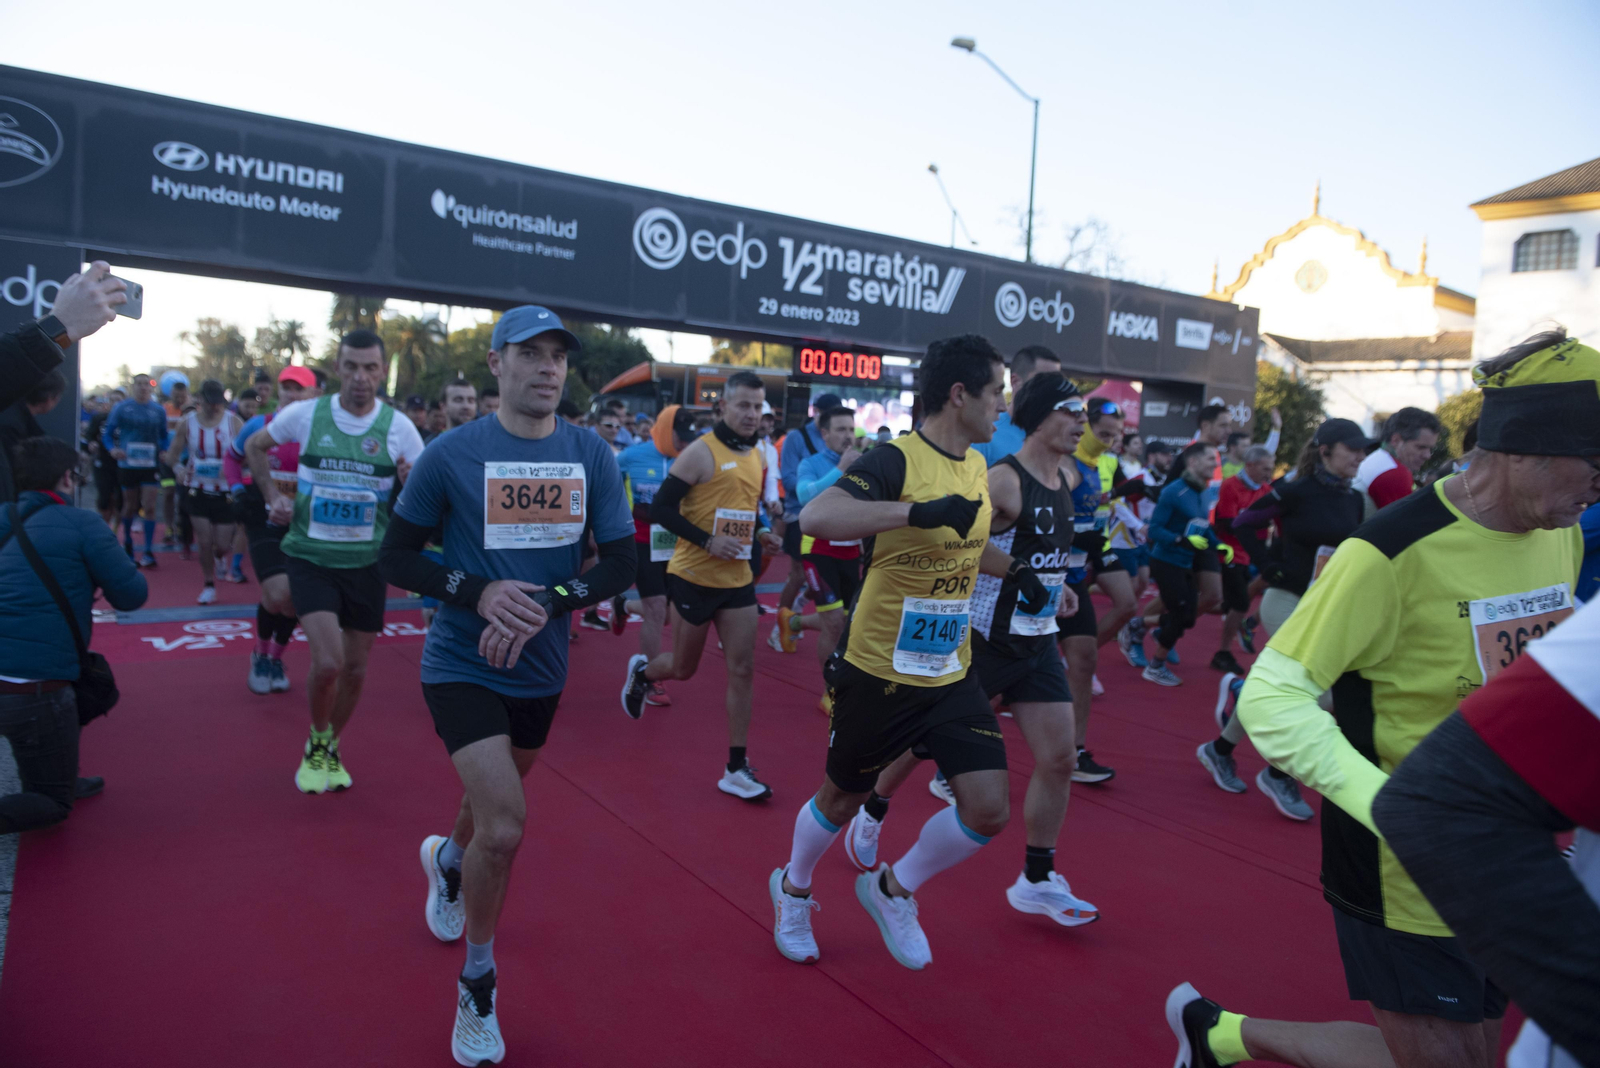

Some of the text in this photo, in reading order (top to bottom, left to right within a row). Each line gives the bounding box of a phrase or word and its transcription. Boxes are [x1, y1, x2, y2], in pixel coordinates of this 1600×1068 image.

[215, 151, 344, 194] HYUNDAI
[152, 175, 342, 222] Hyundauto Motor
[472, 232, 576, 261] Healthcare Partner
[690, 221, 768, 280] edp
[815, 242, 939, 288] maratón
[0, 264, 63, 319] dp
[847, 277, 942, 315] sevilla
[758, 297, 861, 327] 29 enero 2023
[1028, 290, 1075, 334] edp
[1106, 310, 1160, 342] HOKA
[321, 501, 361, 519] 1751
[500, 484, 562, 510] 3642
[722, 522, 750, 538] 4365
[944, 539, 984, 551] WIKABOO
[896, 552, 957, 573] DIOGO
[446, 570, 467, 595] edp
[930, 576, 971, 596] POR
[911, 618, 958, 643] 2140
